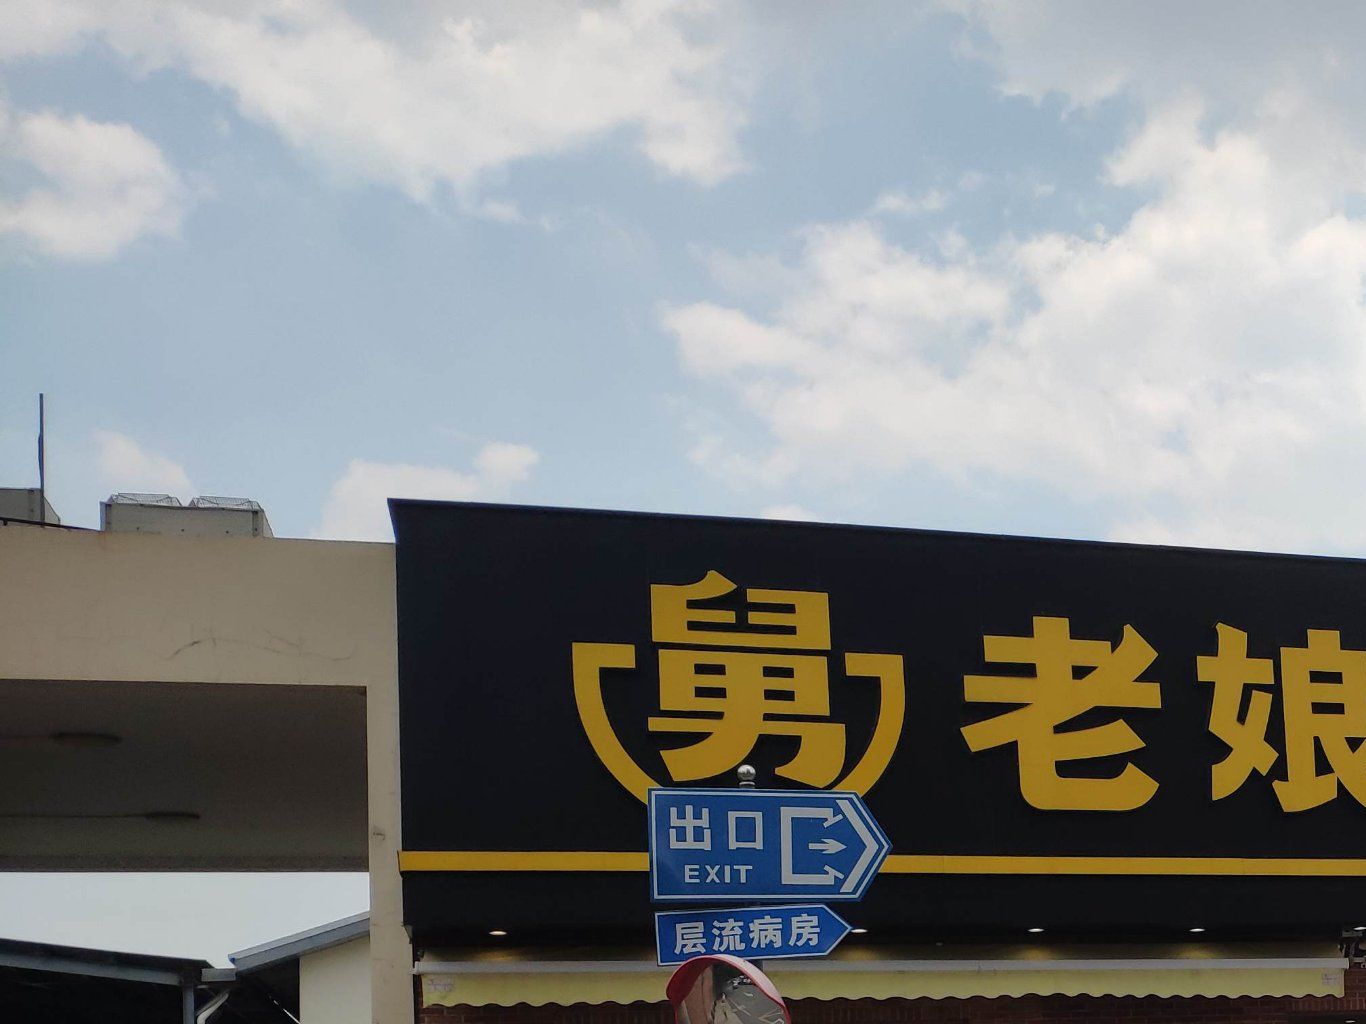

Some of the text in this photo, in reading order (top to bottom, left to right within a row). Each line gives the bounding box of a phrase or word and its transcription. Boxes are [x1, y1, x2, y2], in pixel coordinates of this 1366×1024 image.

[668, 804, 764, 851] 出口
[684, 864, 753, 884] EXIT
[674, 913, 821, 955] 层流病房
